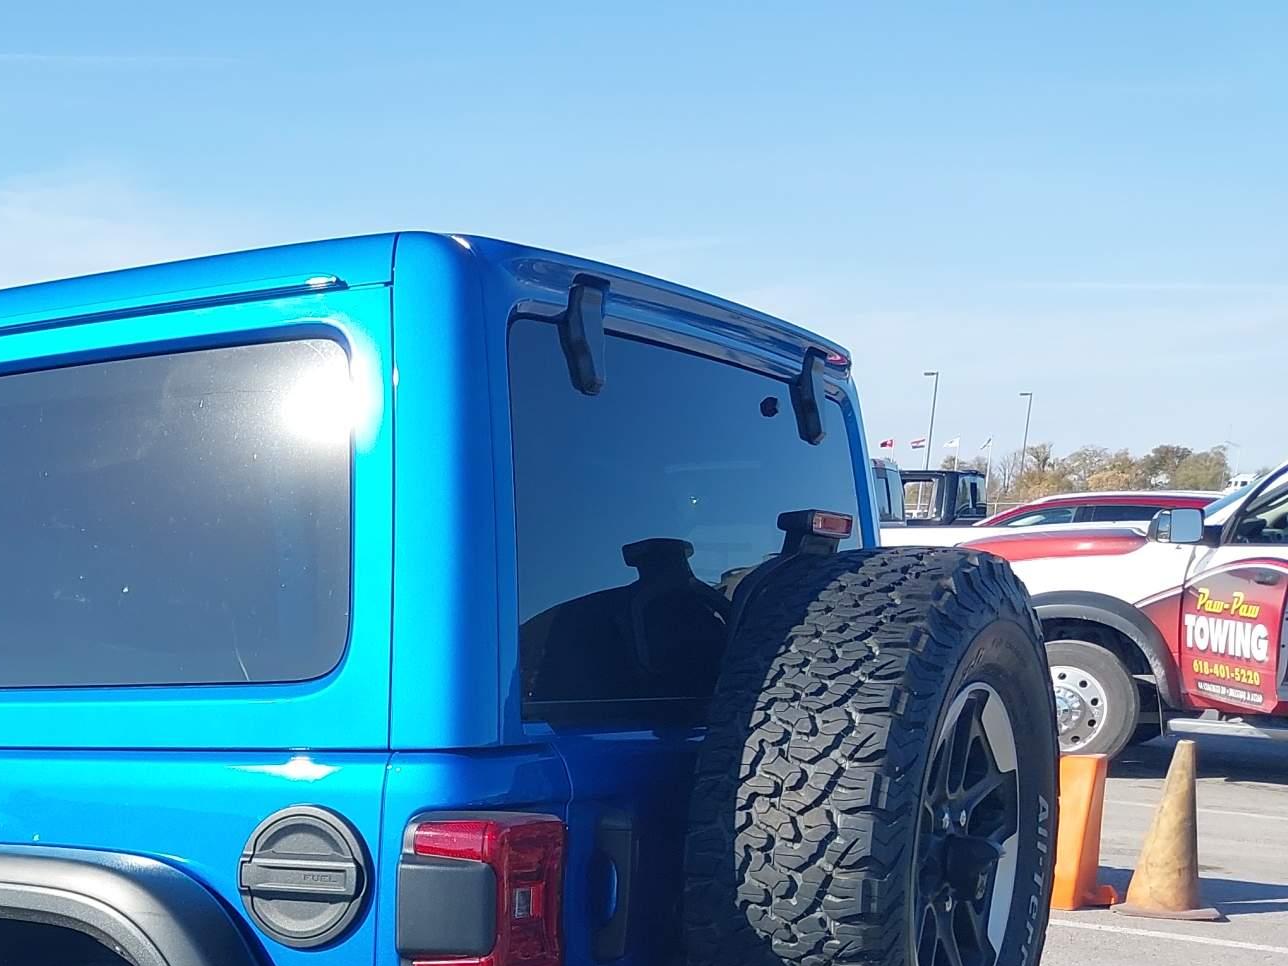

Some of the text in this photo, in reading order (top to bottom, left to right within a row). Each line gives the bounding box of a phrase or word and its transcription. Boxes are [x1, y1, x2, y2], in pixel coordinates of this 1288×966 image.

[1197, 587, 1260, 619] Paw-Paw
[1184, 613, 1269, 662] TOWING
[1192, 659, 1261, 686] 618-401-5220
[303, 873, 337, 883] FUEL
